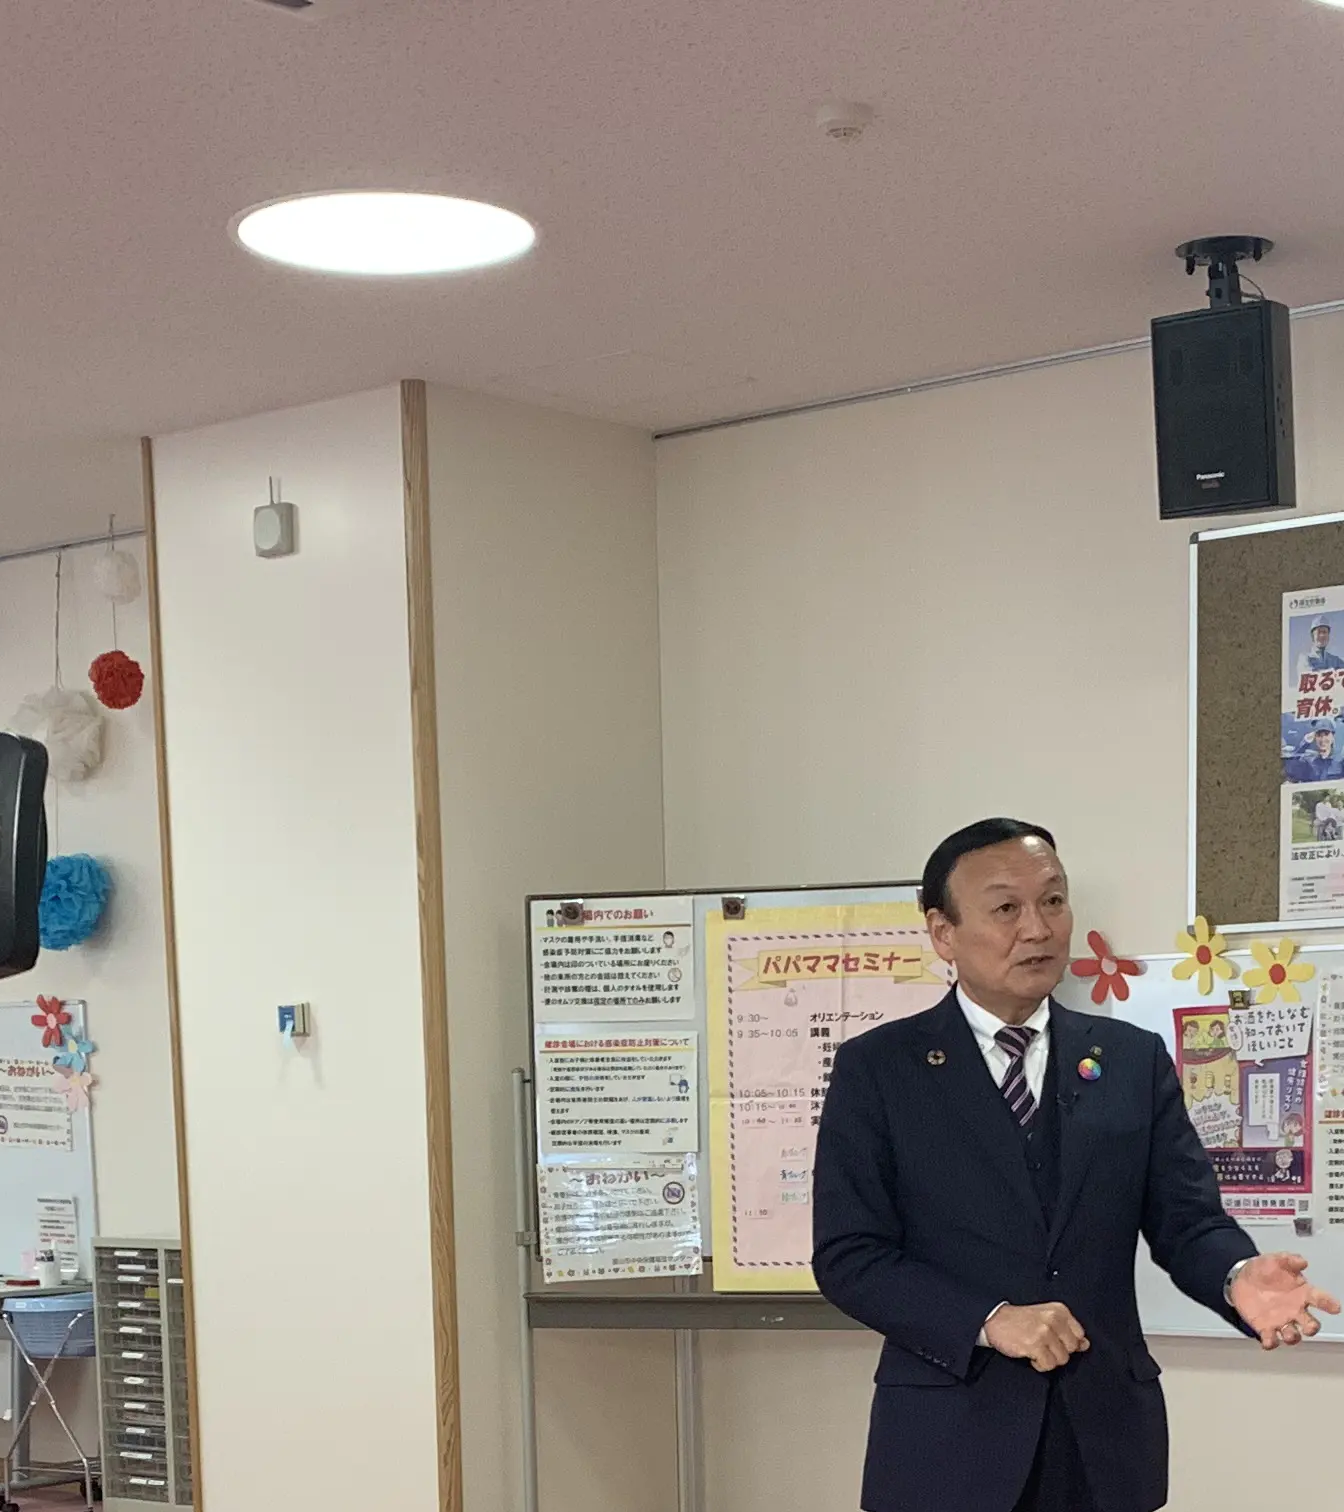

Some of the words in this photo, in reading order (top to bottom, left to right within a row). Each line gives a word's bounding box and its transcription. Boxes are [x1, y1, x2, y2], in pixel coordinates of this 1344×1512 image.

[1296, 695, 1339, 719] 育休。
[762, 951, 922, 975] パパママセミナー
[809, 1010, 885, 1022] オリエンテーション
[1245, 1022, 1306, 1037] 知っておいて
[1247, 1036, 1294, 1052] ほしいこと
